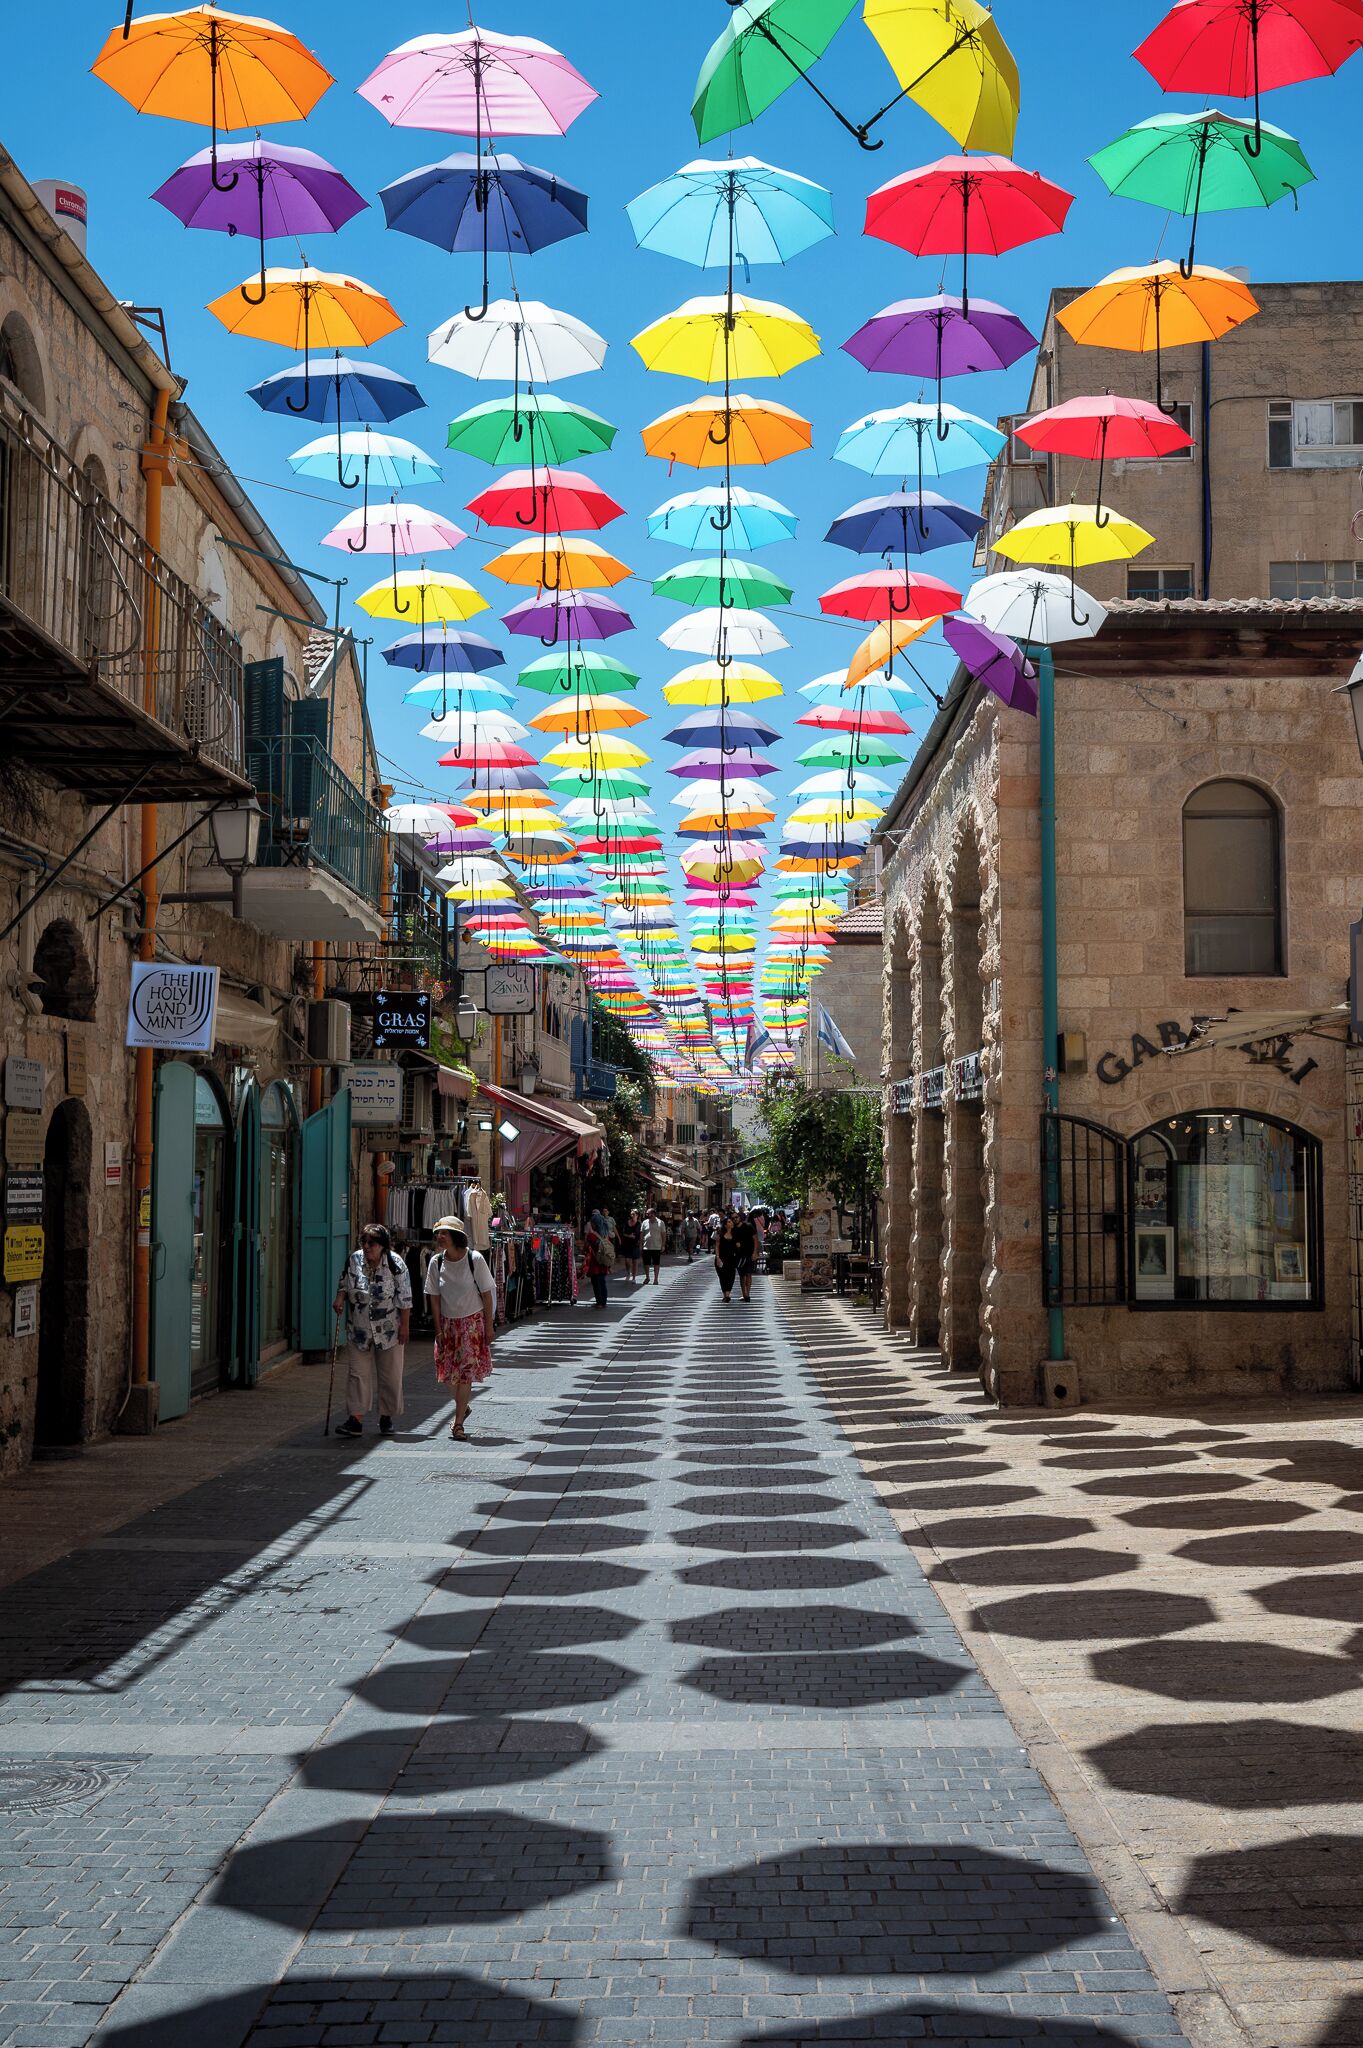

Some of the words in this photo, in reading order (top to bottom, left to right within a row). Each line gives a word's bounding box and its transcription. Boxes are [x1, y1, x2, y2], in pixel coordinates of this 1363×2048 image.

[161, 973, 189, 987] THE
[150, 986, 188, 1004] HOLY
[147, 1001, 187, 1016] LAND
[146, 1015, 187, 1030] MINT
[378, 1012, 426, 1028] GRAS
[346, 1079, 373, 1088] כנסת
[376, 1079, 396, 1088] בית
[351, 1096, 375, 1104] חסידי
[378, 1092, 395, 1107] קהל
